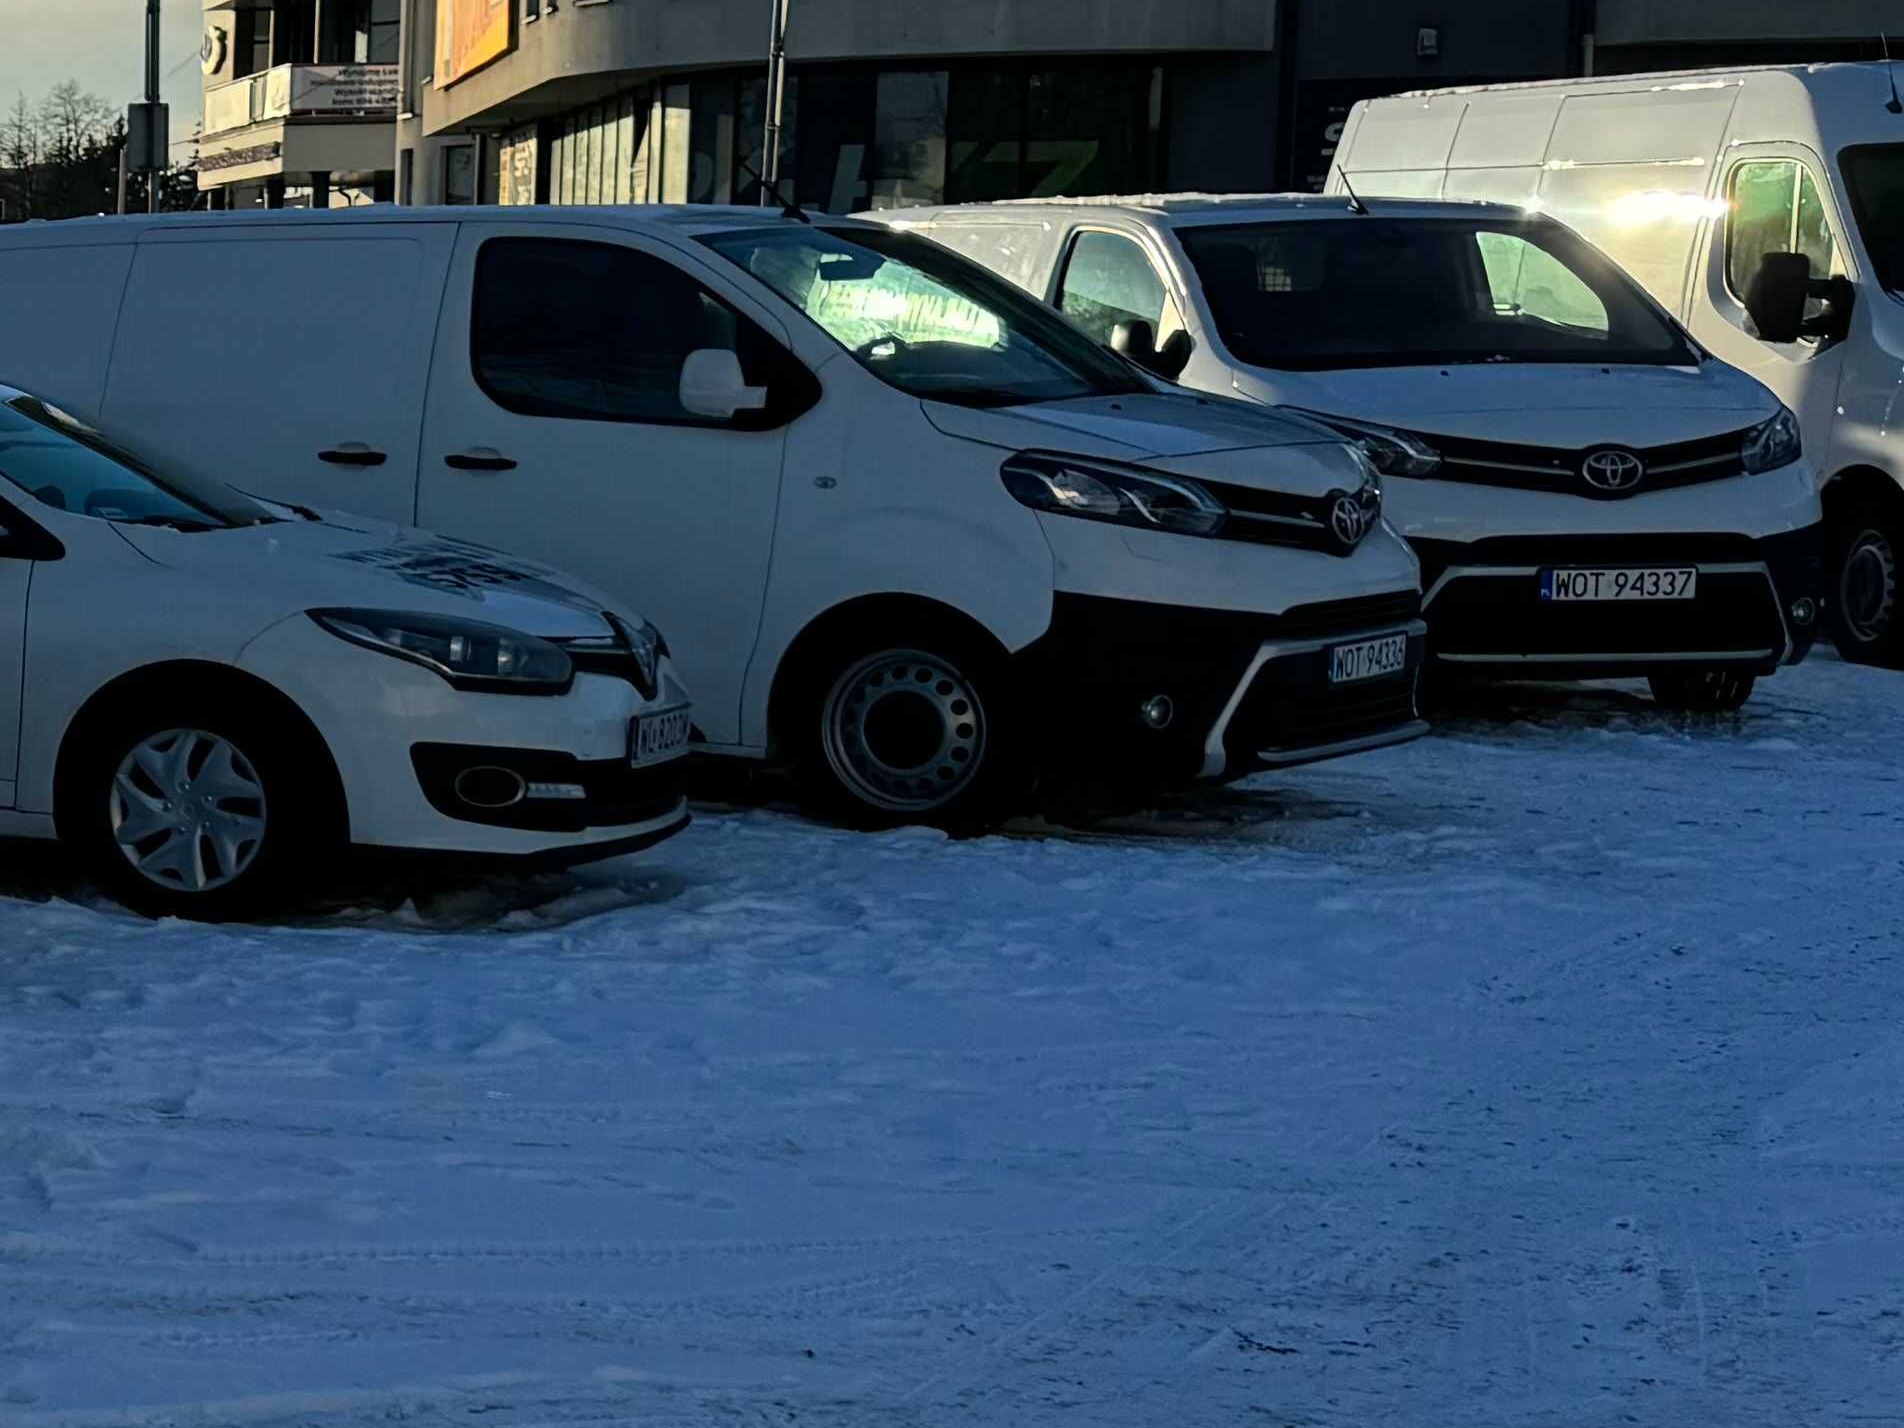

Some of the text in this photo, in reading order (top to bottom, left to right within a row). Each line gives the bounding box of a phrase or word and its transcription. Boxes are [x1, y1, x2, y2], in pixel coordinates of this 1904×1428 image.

[1556, 571, 1693, 597] WOT 94337
[1334, 635, 1404, 679] WOT 94336
